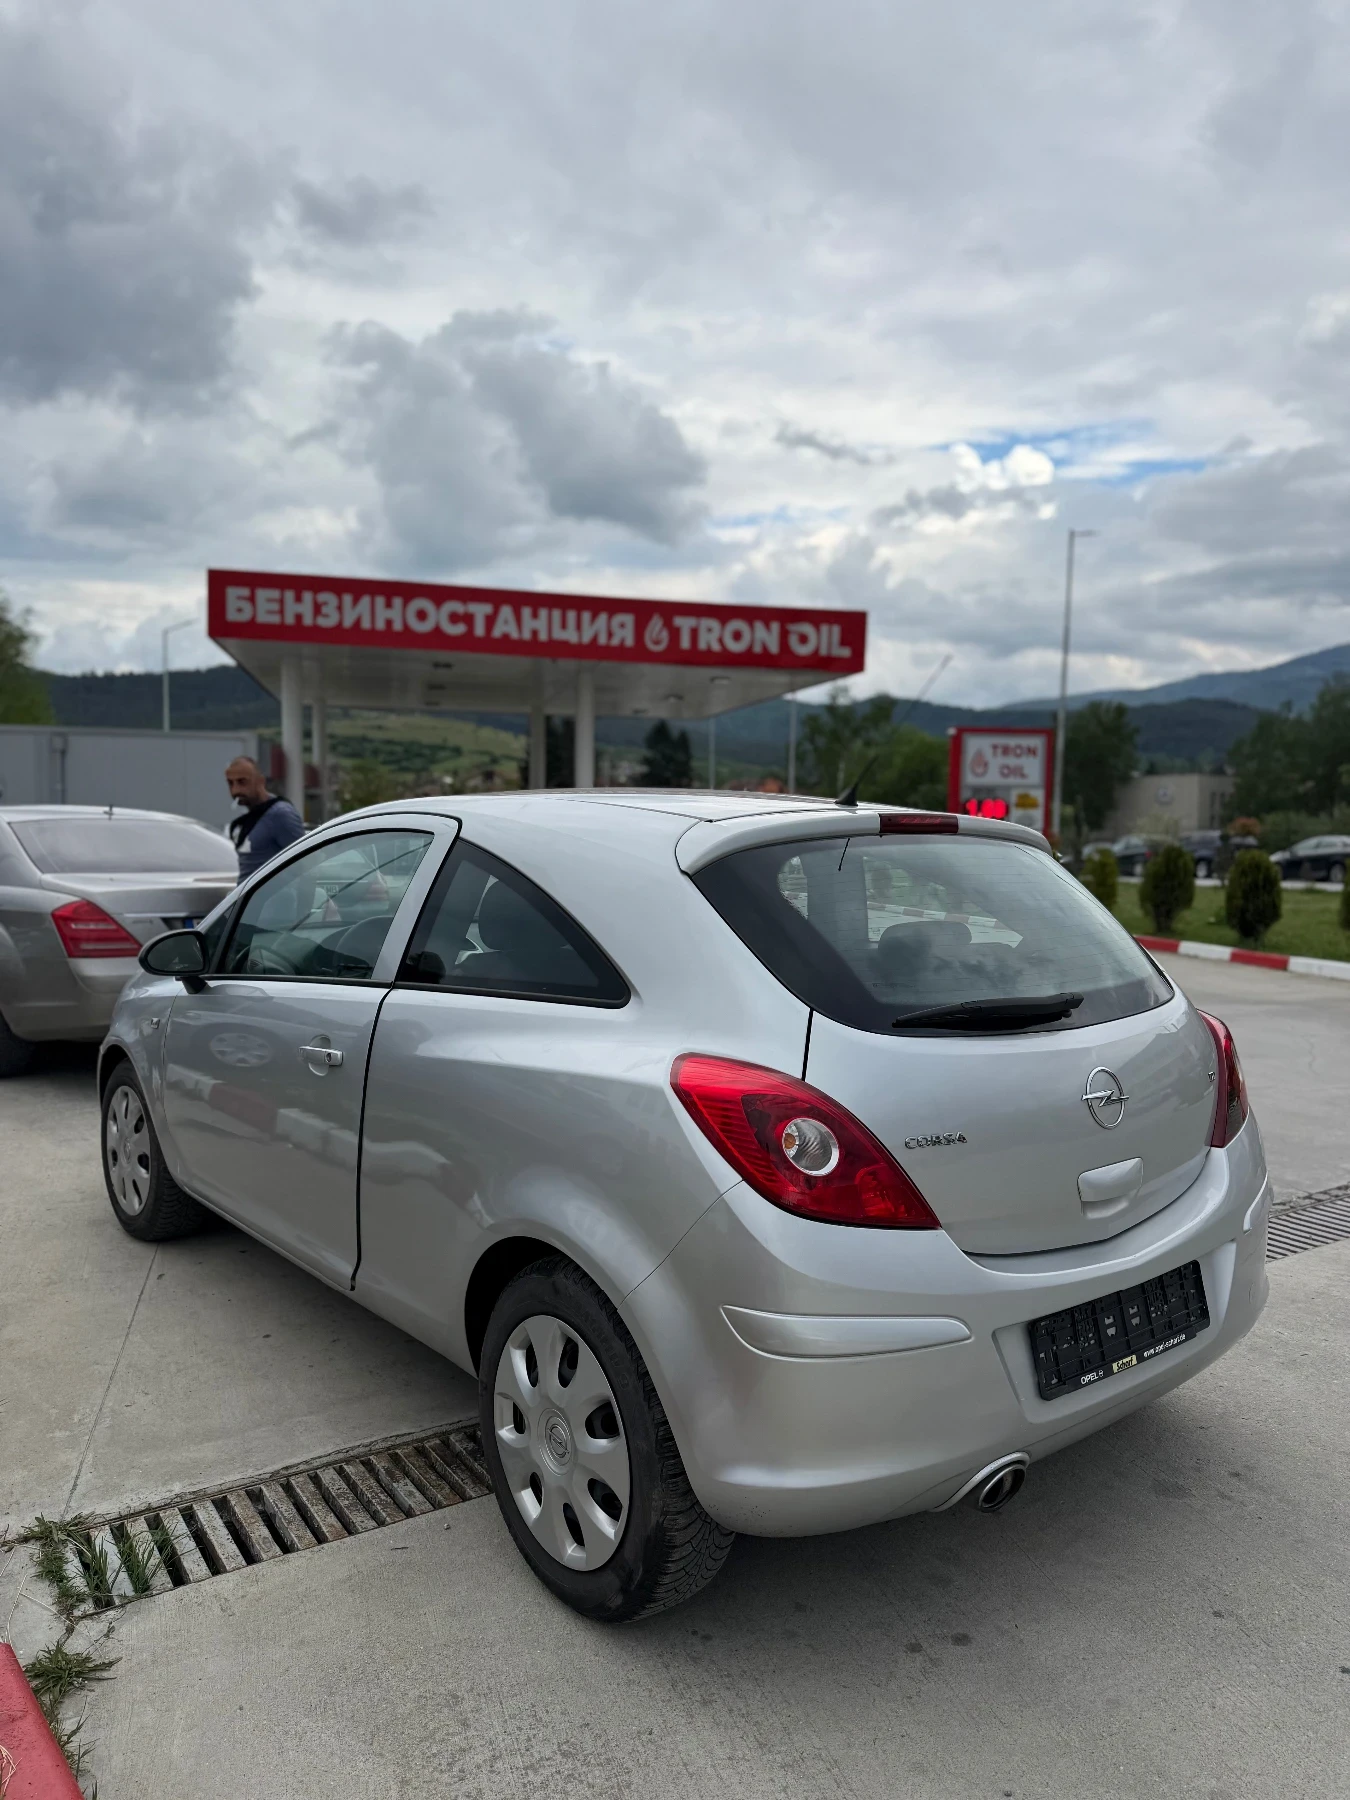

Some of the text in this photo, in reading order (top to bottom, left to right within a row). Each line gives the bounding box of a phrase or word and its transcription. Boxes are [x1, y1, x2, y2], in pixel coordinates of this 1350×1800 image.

[225, 585, 636, 648] БЕНЗИНОСТАНЦИЯ
[672, 615, 853, 659] TRON OIL
[991, 743, 1038, 759] TRON
[999, 764, 1028, 779] OIL
[904, 1131, 968, 1150] CORSA
[1080, 1371, 1099, 1385] OPEL
